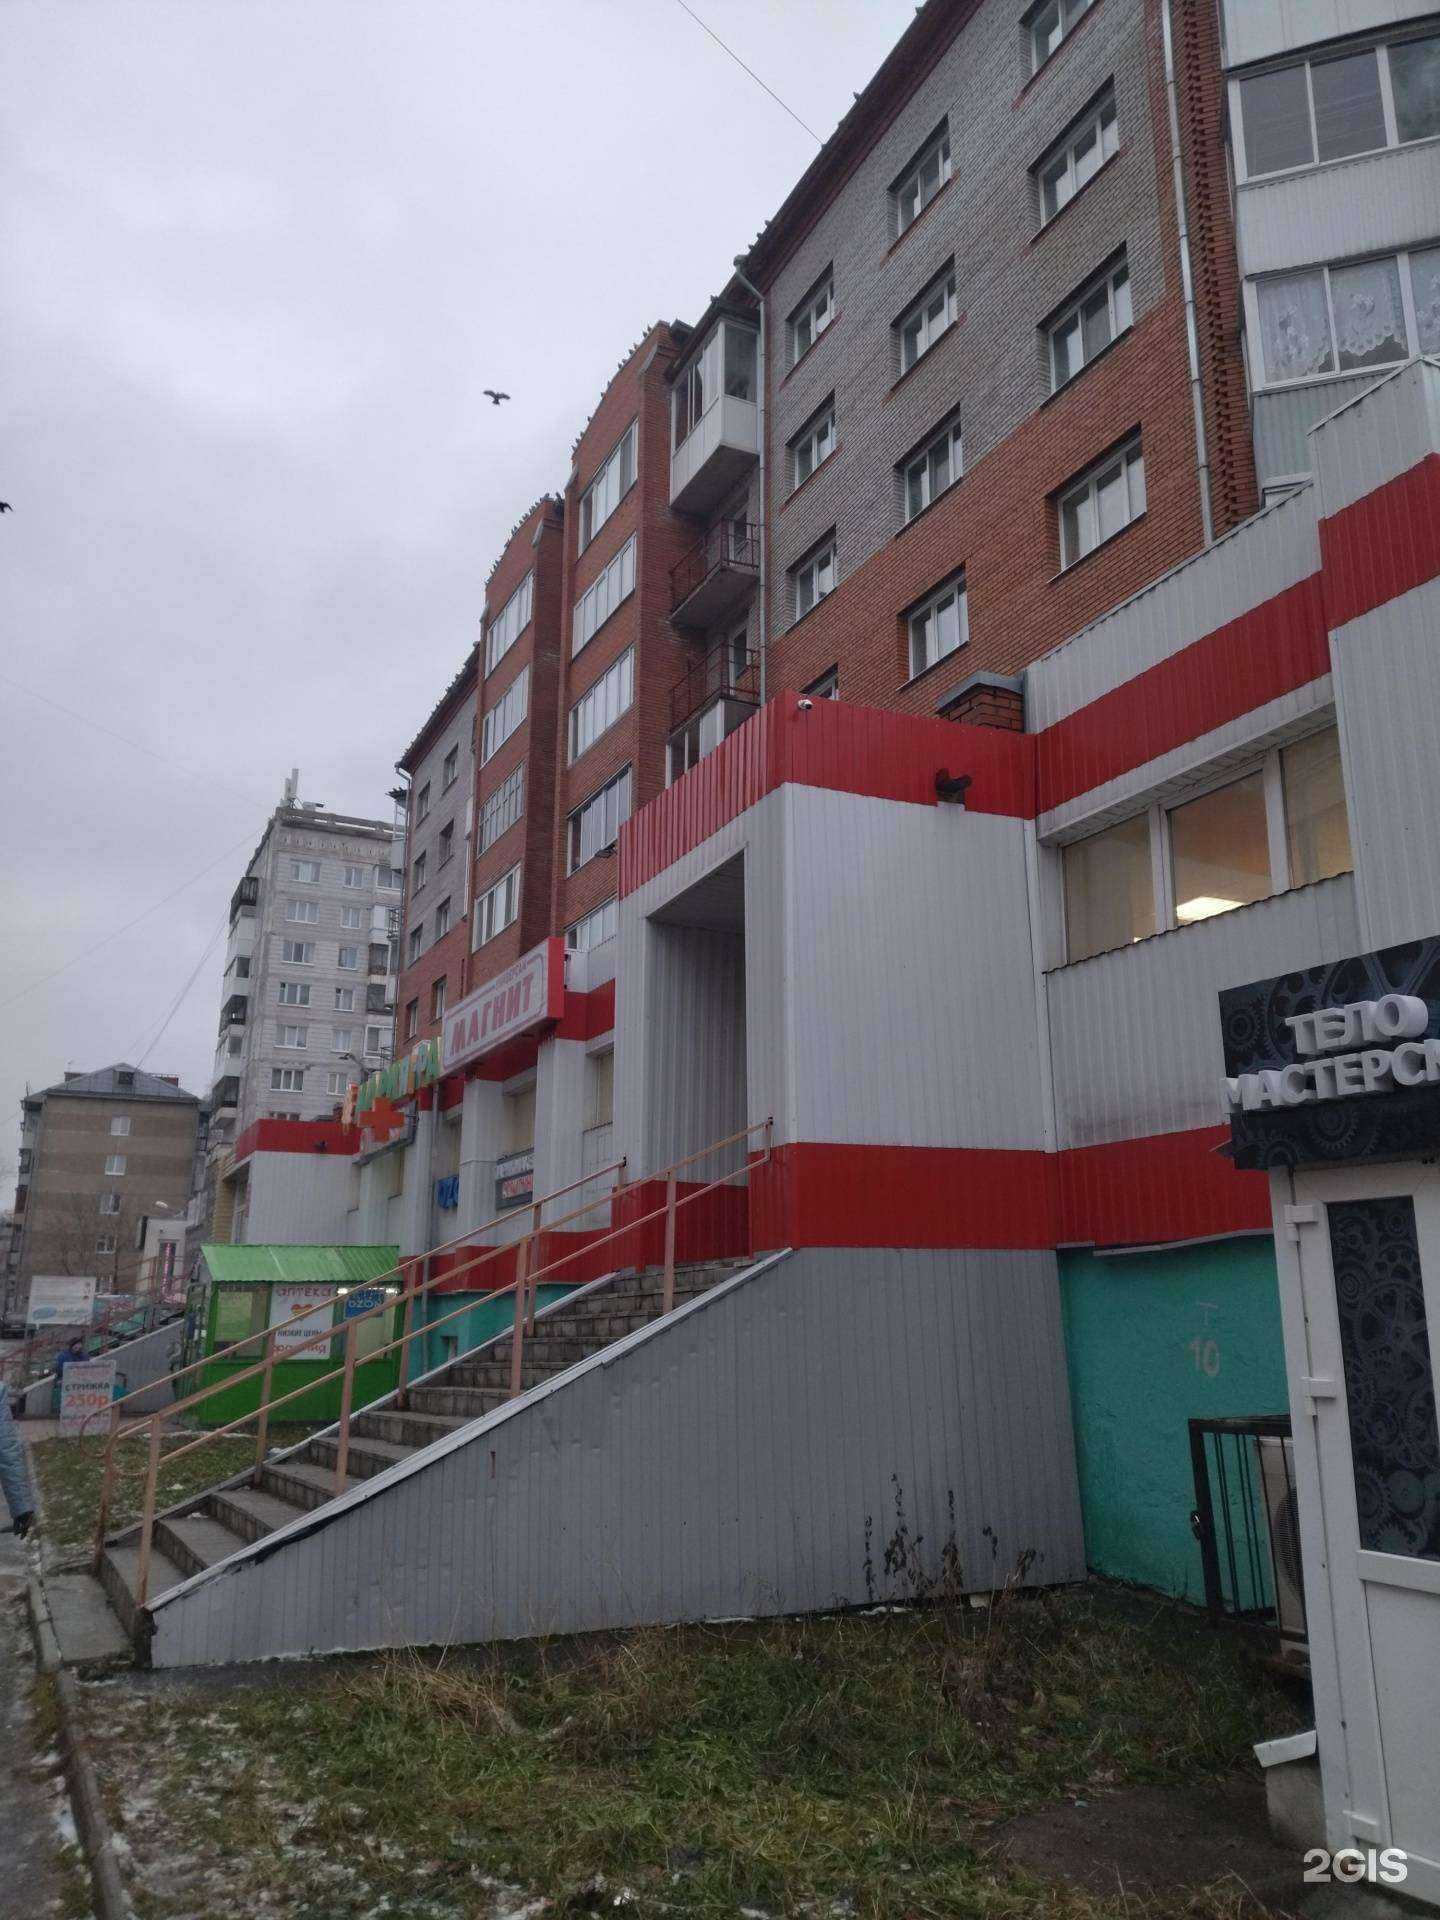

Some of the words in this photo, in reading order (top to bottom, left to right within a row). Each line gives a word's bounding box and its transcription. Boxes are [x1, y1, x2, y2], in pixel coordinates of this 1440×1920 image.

[450, 971, 534, 1057] МАГНИТ
[1285, 994, 1429, 1055] ТЕЛО
[1188, 1335, 1221, 1377] 10
[65, 1383, 110, 1392] СТРИЖКА
